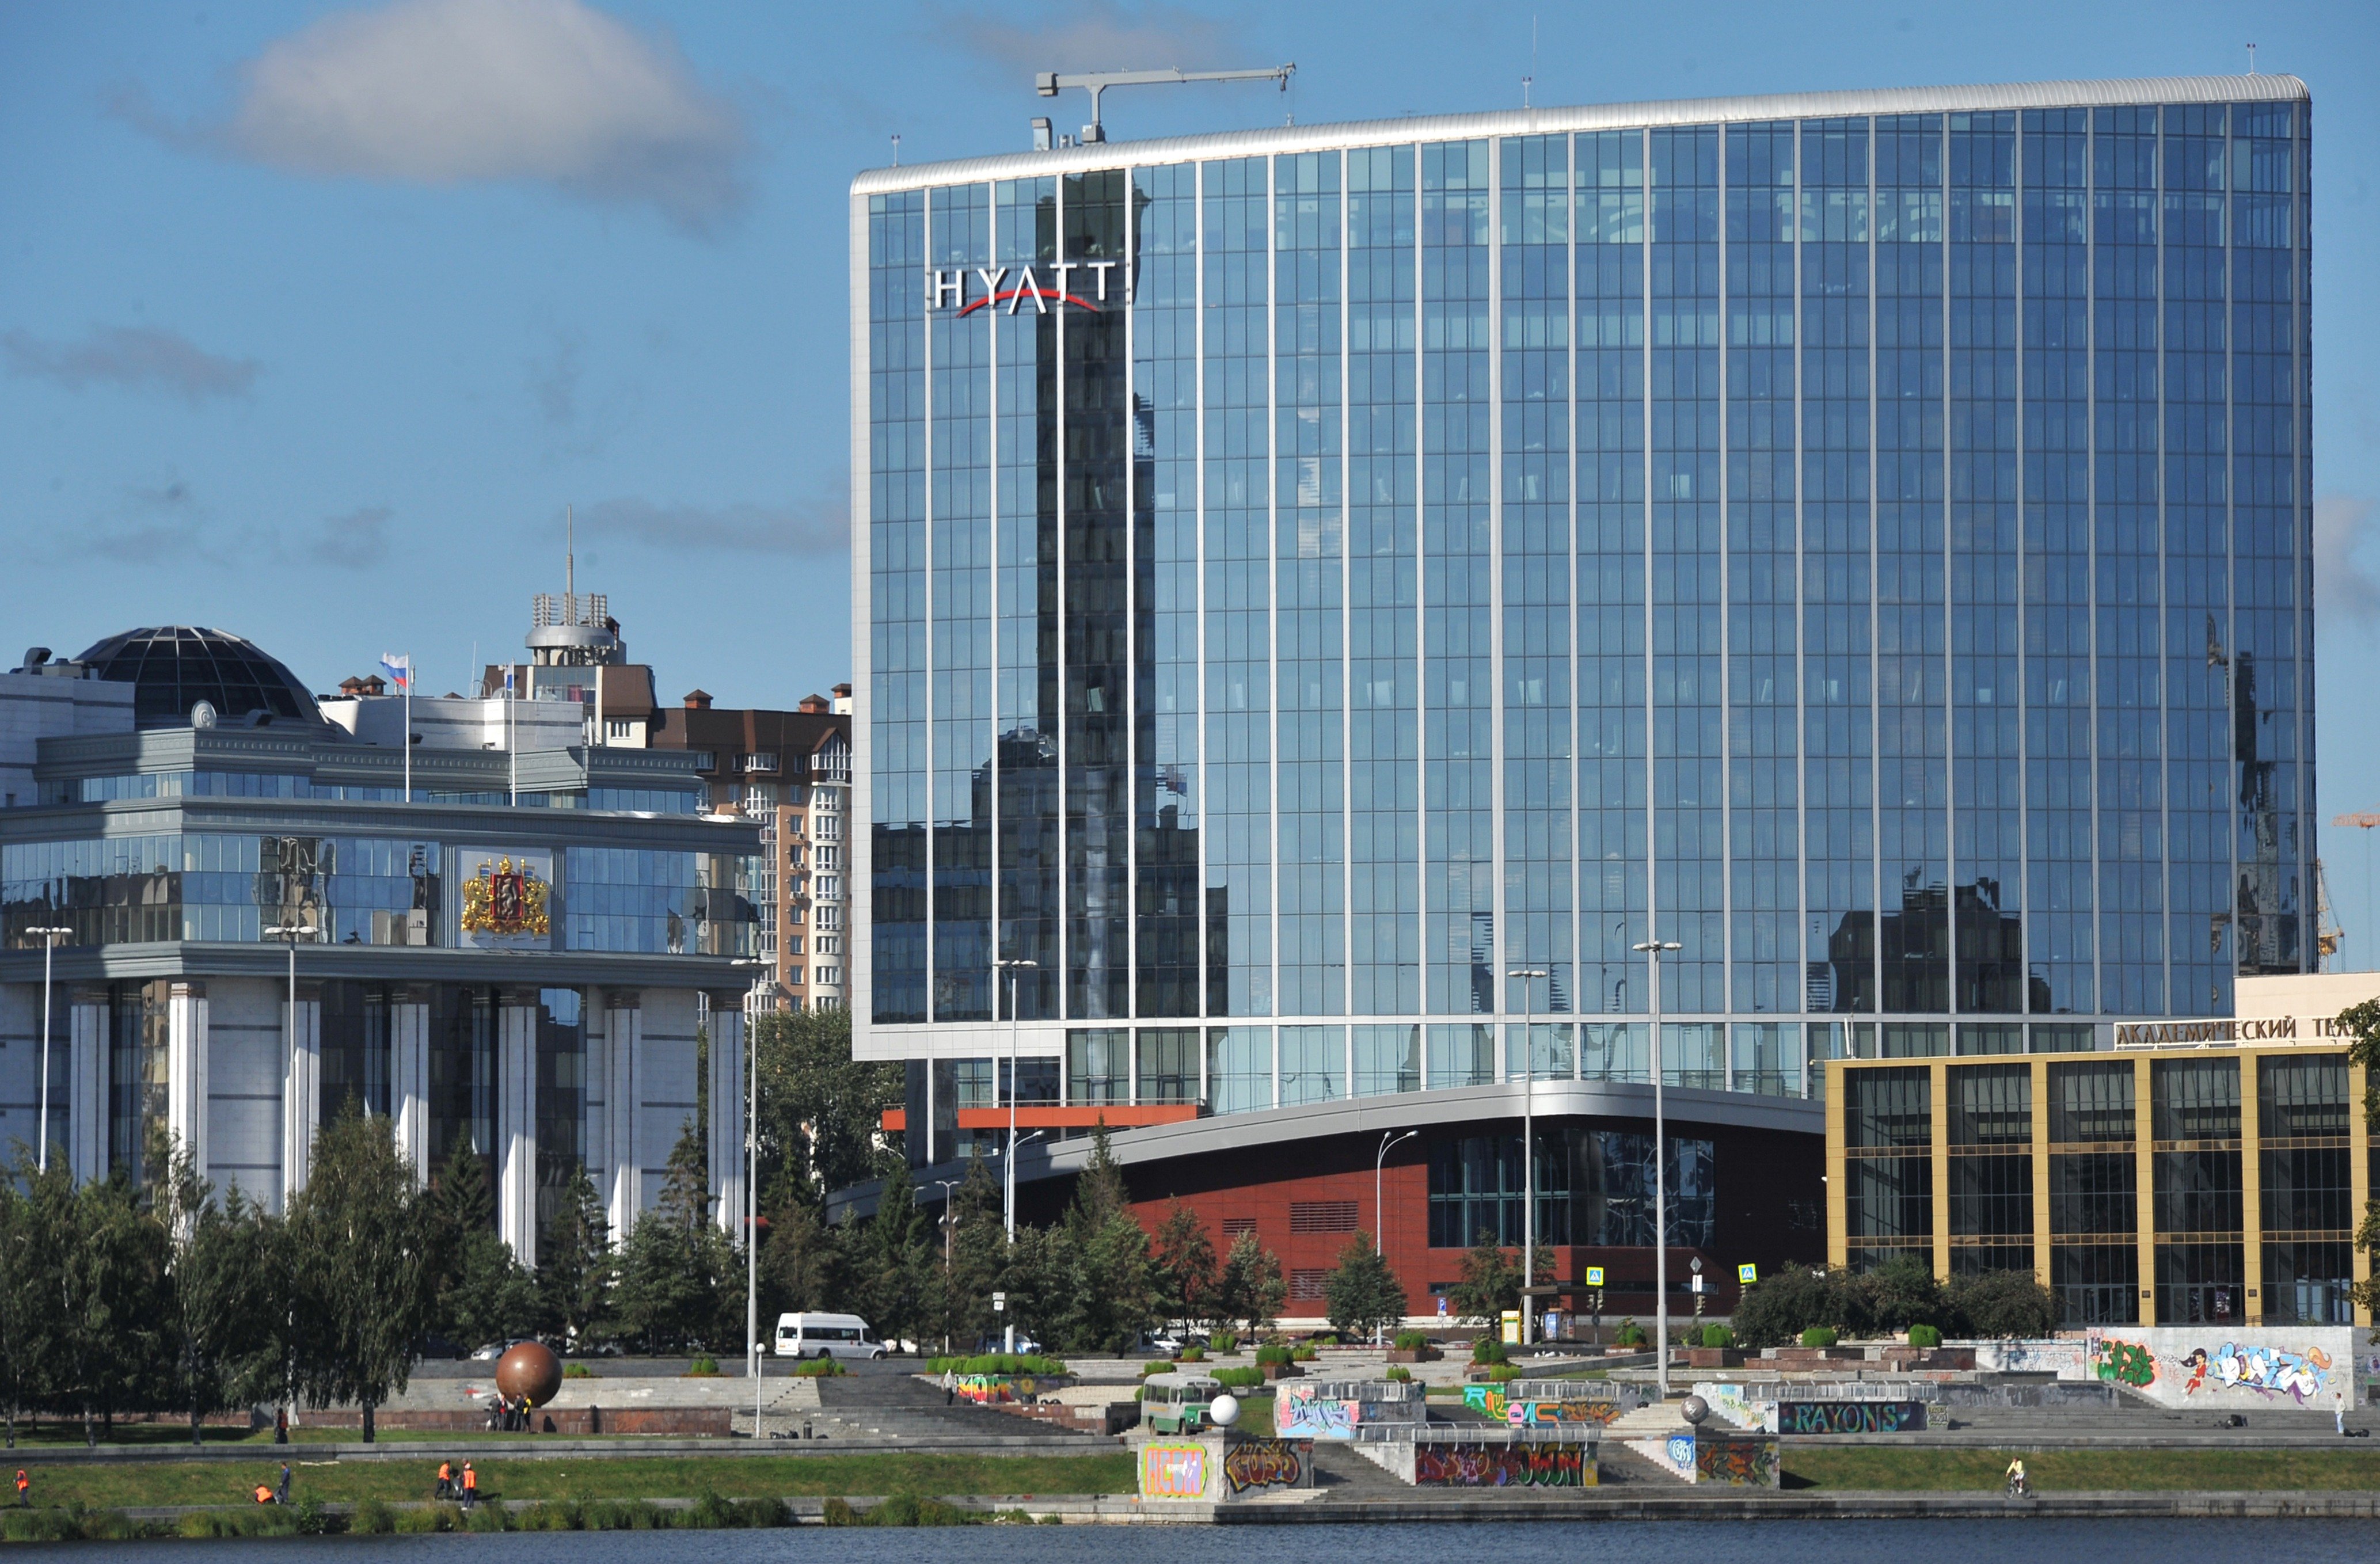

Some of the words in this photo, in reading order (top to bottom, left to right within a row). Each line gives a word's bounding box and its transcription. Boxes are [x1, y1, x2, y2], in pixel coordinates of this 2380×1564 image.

[935, 261, 1116, 315] HYATT
[2117, 1015, 2297, 1044] АКАДЕМИЧЕСКИЙ
[1463, 1386, 1560, 1428] RAYONS
[1793, 1403, 1898, 1433] RAYONS
